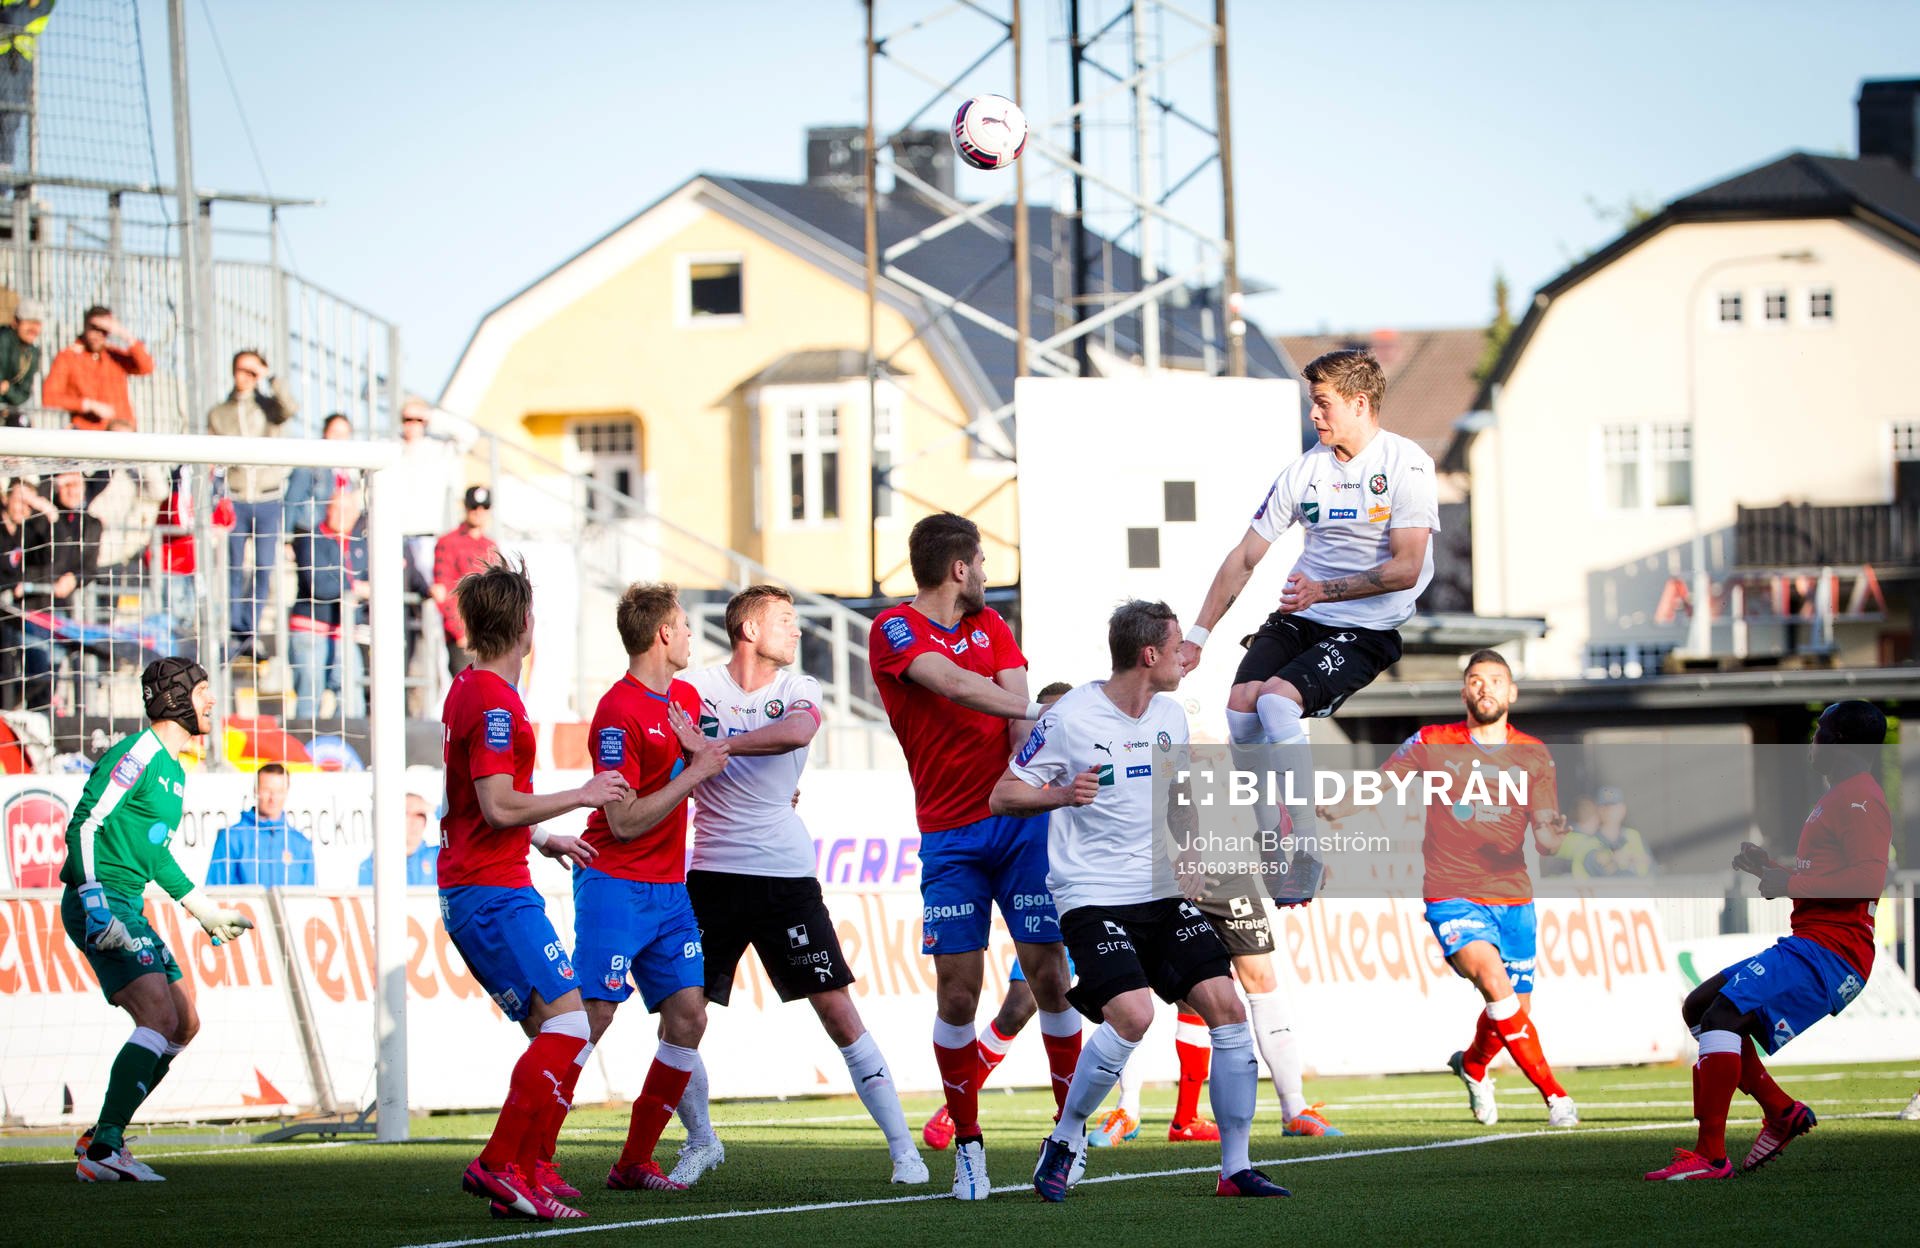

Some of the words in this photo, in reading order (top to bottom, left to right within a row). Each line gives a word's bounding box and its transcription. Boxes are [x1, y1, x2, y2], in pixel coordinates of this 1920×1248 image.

[933, 903, 975, 918] SOLID
[1025, 916, 1041, 932] 42
[820, 974, 826, 983] 6
